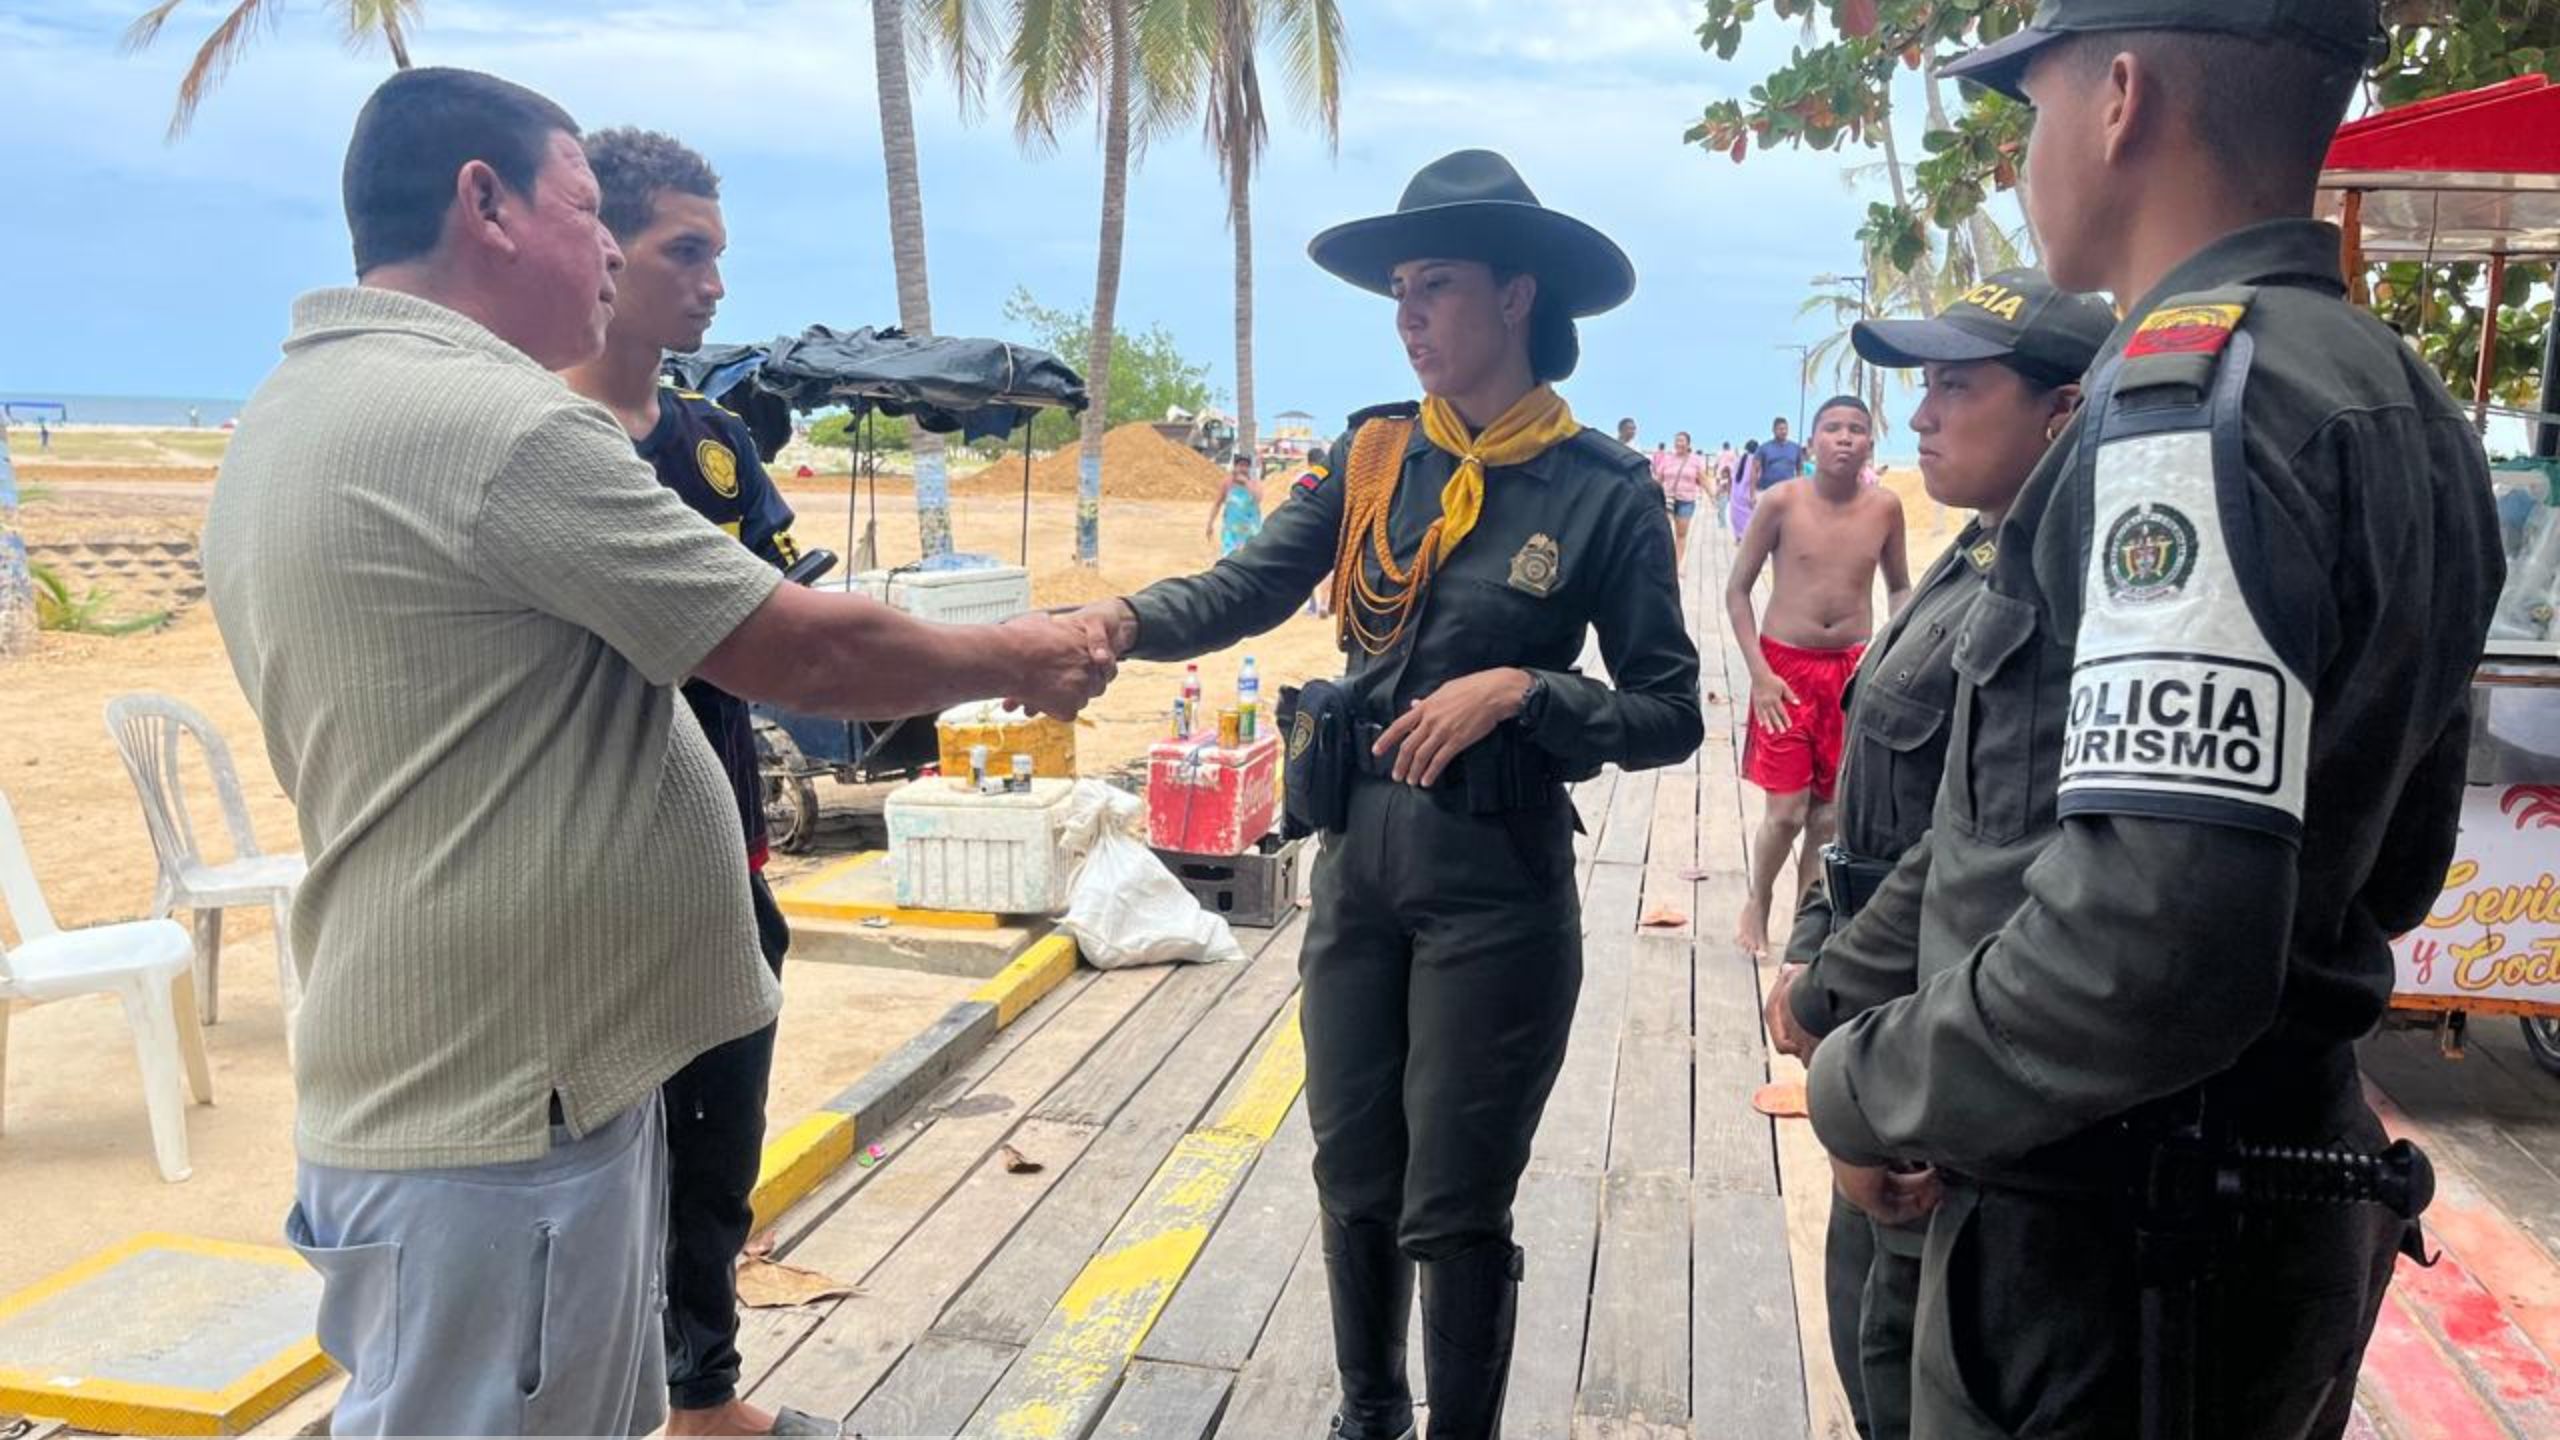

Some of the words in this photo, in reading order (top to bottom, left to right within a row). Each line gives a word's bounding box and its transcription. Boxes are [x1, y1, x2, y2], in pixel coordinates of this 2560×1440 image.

[2071, 671, 2261, 738] OLICÍA
[2063, 729, 2261, 774] URISMO
[2424, 860, 2560, 928] Cevic
[2411, 939, 2438, 984] y
[2447, 933, 2560, 991] Coct
